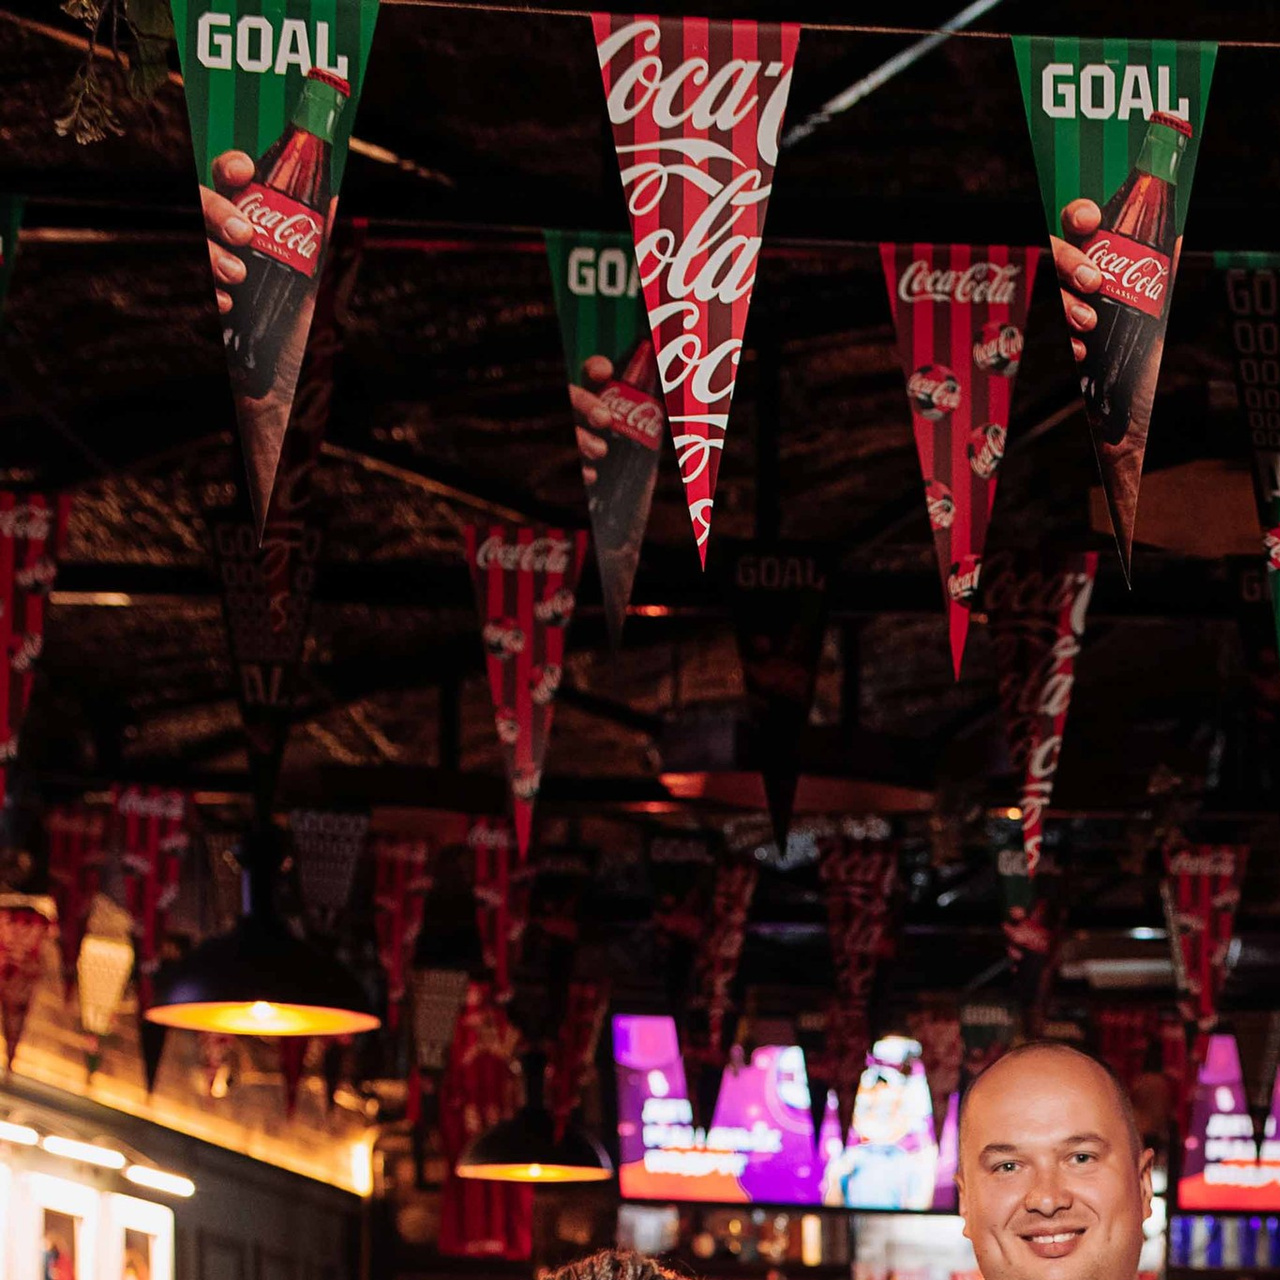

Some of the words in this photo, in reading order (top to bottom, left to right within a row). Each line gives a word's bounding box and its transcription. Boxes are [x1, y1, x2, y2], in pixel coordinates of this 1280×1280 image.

[197, 12, 349, 80] GOAL
[1042, 62, 1190, 122] GOAL
[898, 259, 1022, 304] Coca-Cola
